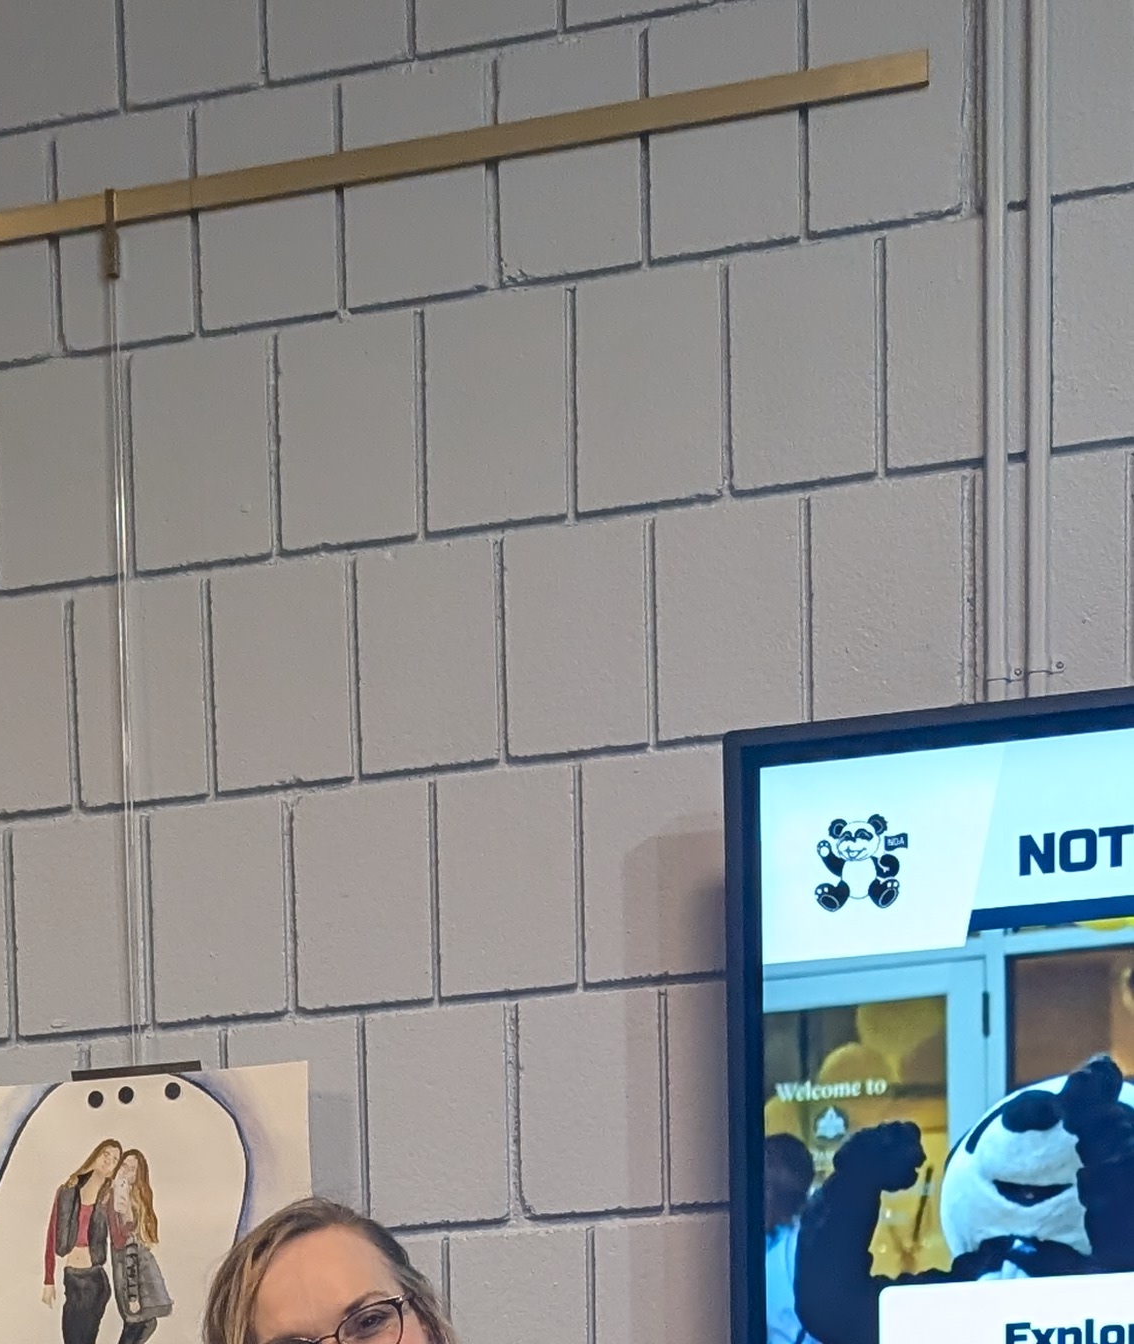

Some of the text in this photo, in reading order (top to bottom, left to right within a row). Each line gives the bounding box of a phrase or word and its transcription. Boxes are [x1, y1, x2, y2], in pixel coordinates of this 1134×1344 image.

[1018, 824, 1134, 877] NOT
[775, 1078, 888, 1103] Welcome to
